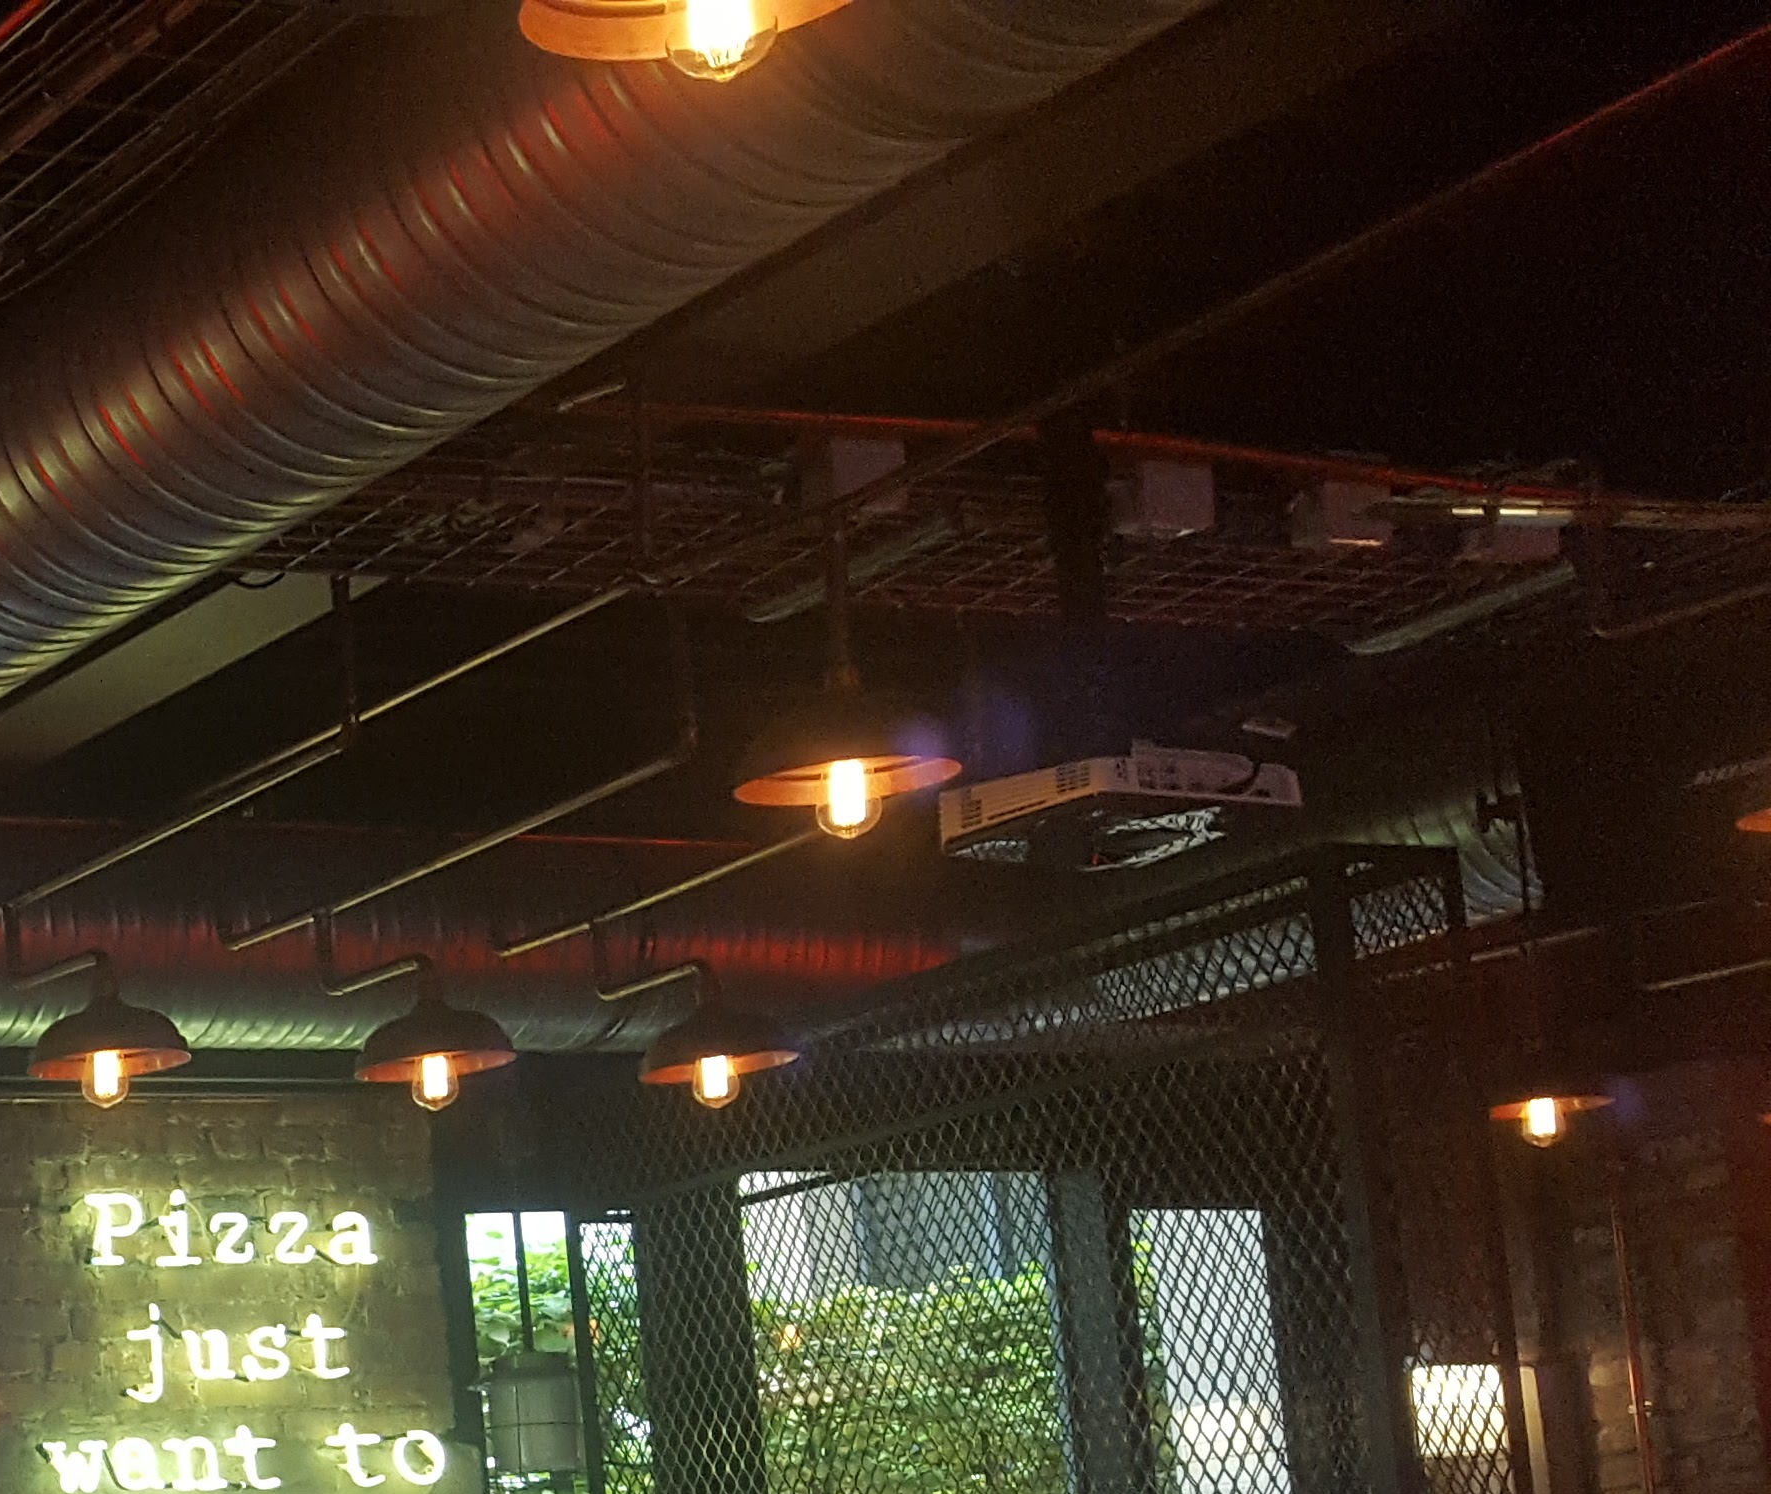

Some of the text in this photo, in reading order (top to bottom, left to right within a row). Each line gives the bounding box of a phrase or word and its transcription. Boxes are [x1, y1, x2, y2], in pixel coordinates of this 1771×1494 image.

[82, 1188, 378, 1266] Pizza
[125, 1302, 350, 1403] just
[42, 1422, 447, 1494] want to
